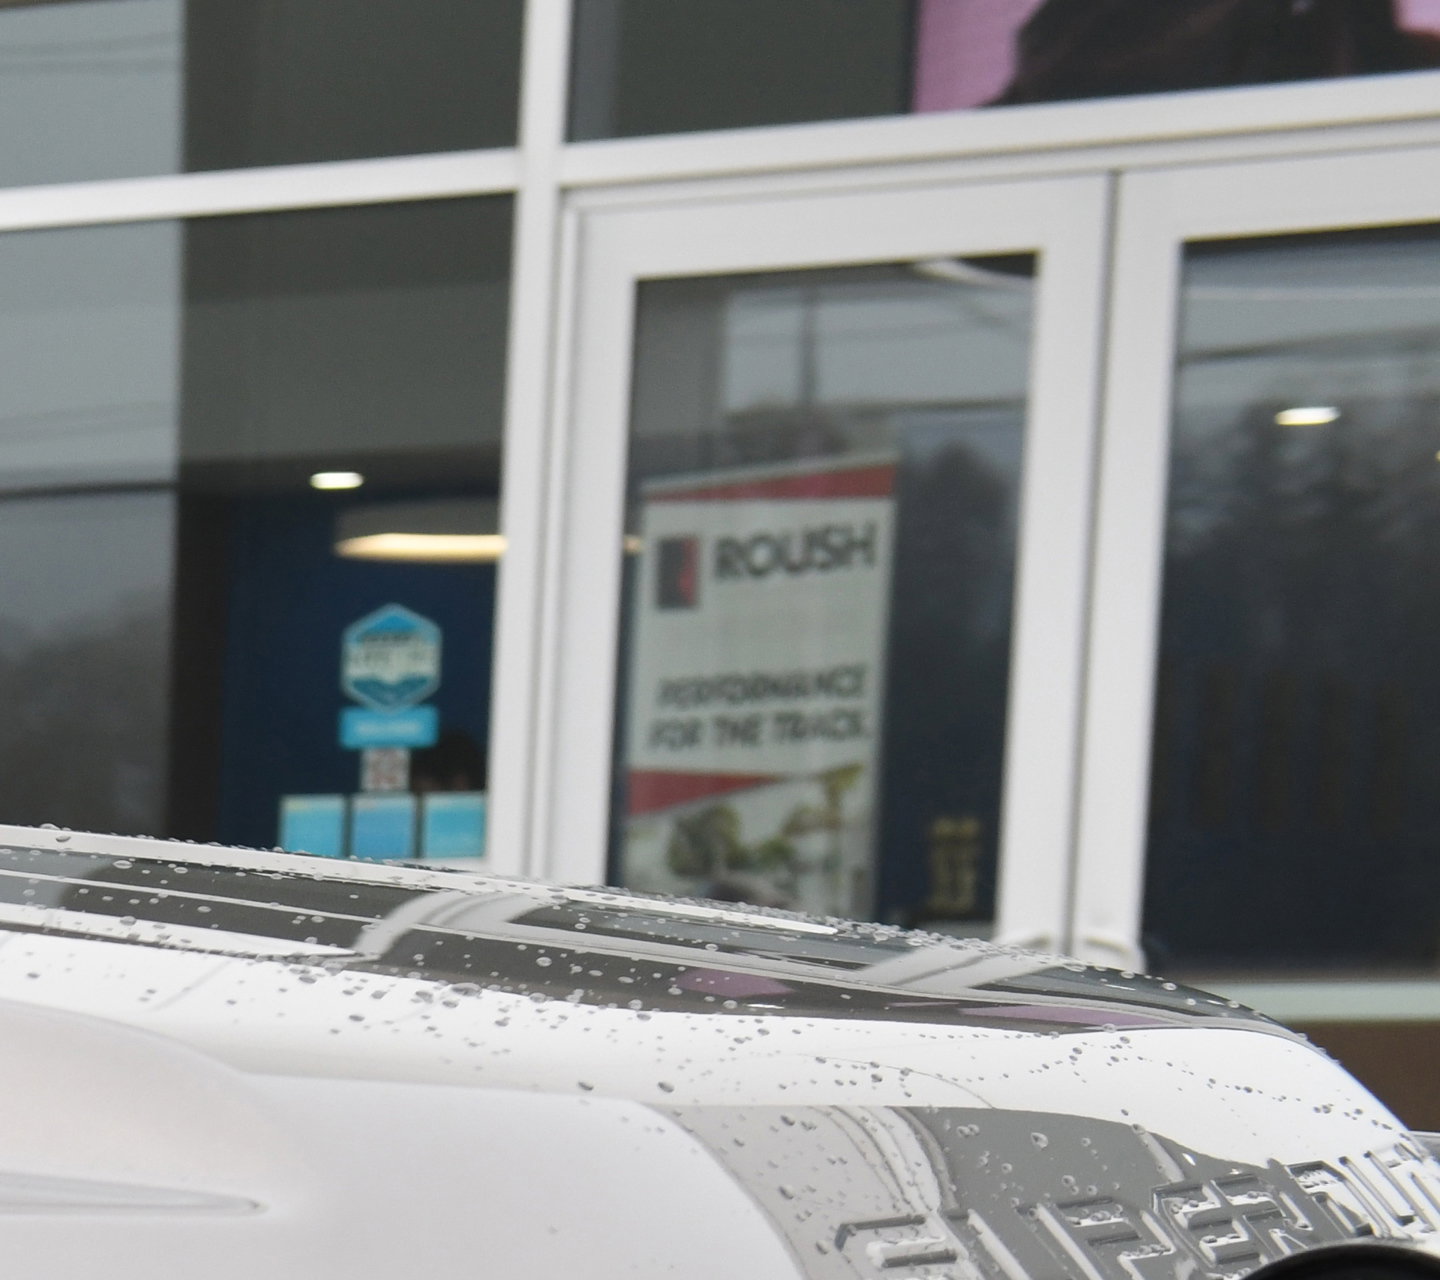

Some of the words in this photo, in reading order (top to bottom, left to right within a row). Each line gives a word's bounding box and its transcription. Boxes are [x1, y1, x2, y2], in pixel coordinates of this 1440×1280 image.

[713, 523, 876, 581] ROUSH
[656, 662, 868, 708] PERFORMANCE
[647, 716, 703, 750] FOR
[713, 712, 762, 748] THE
